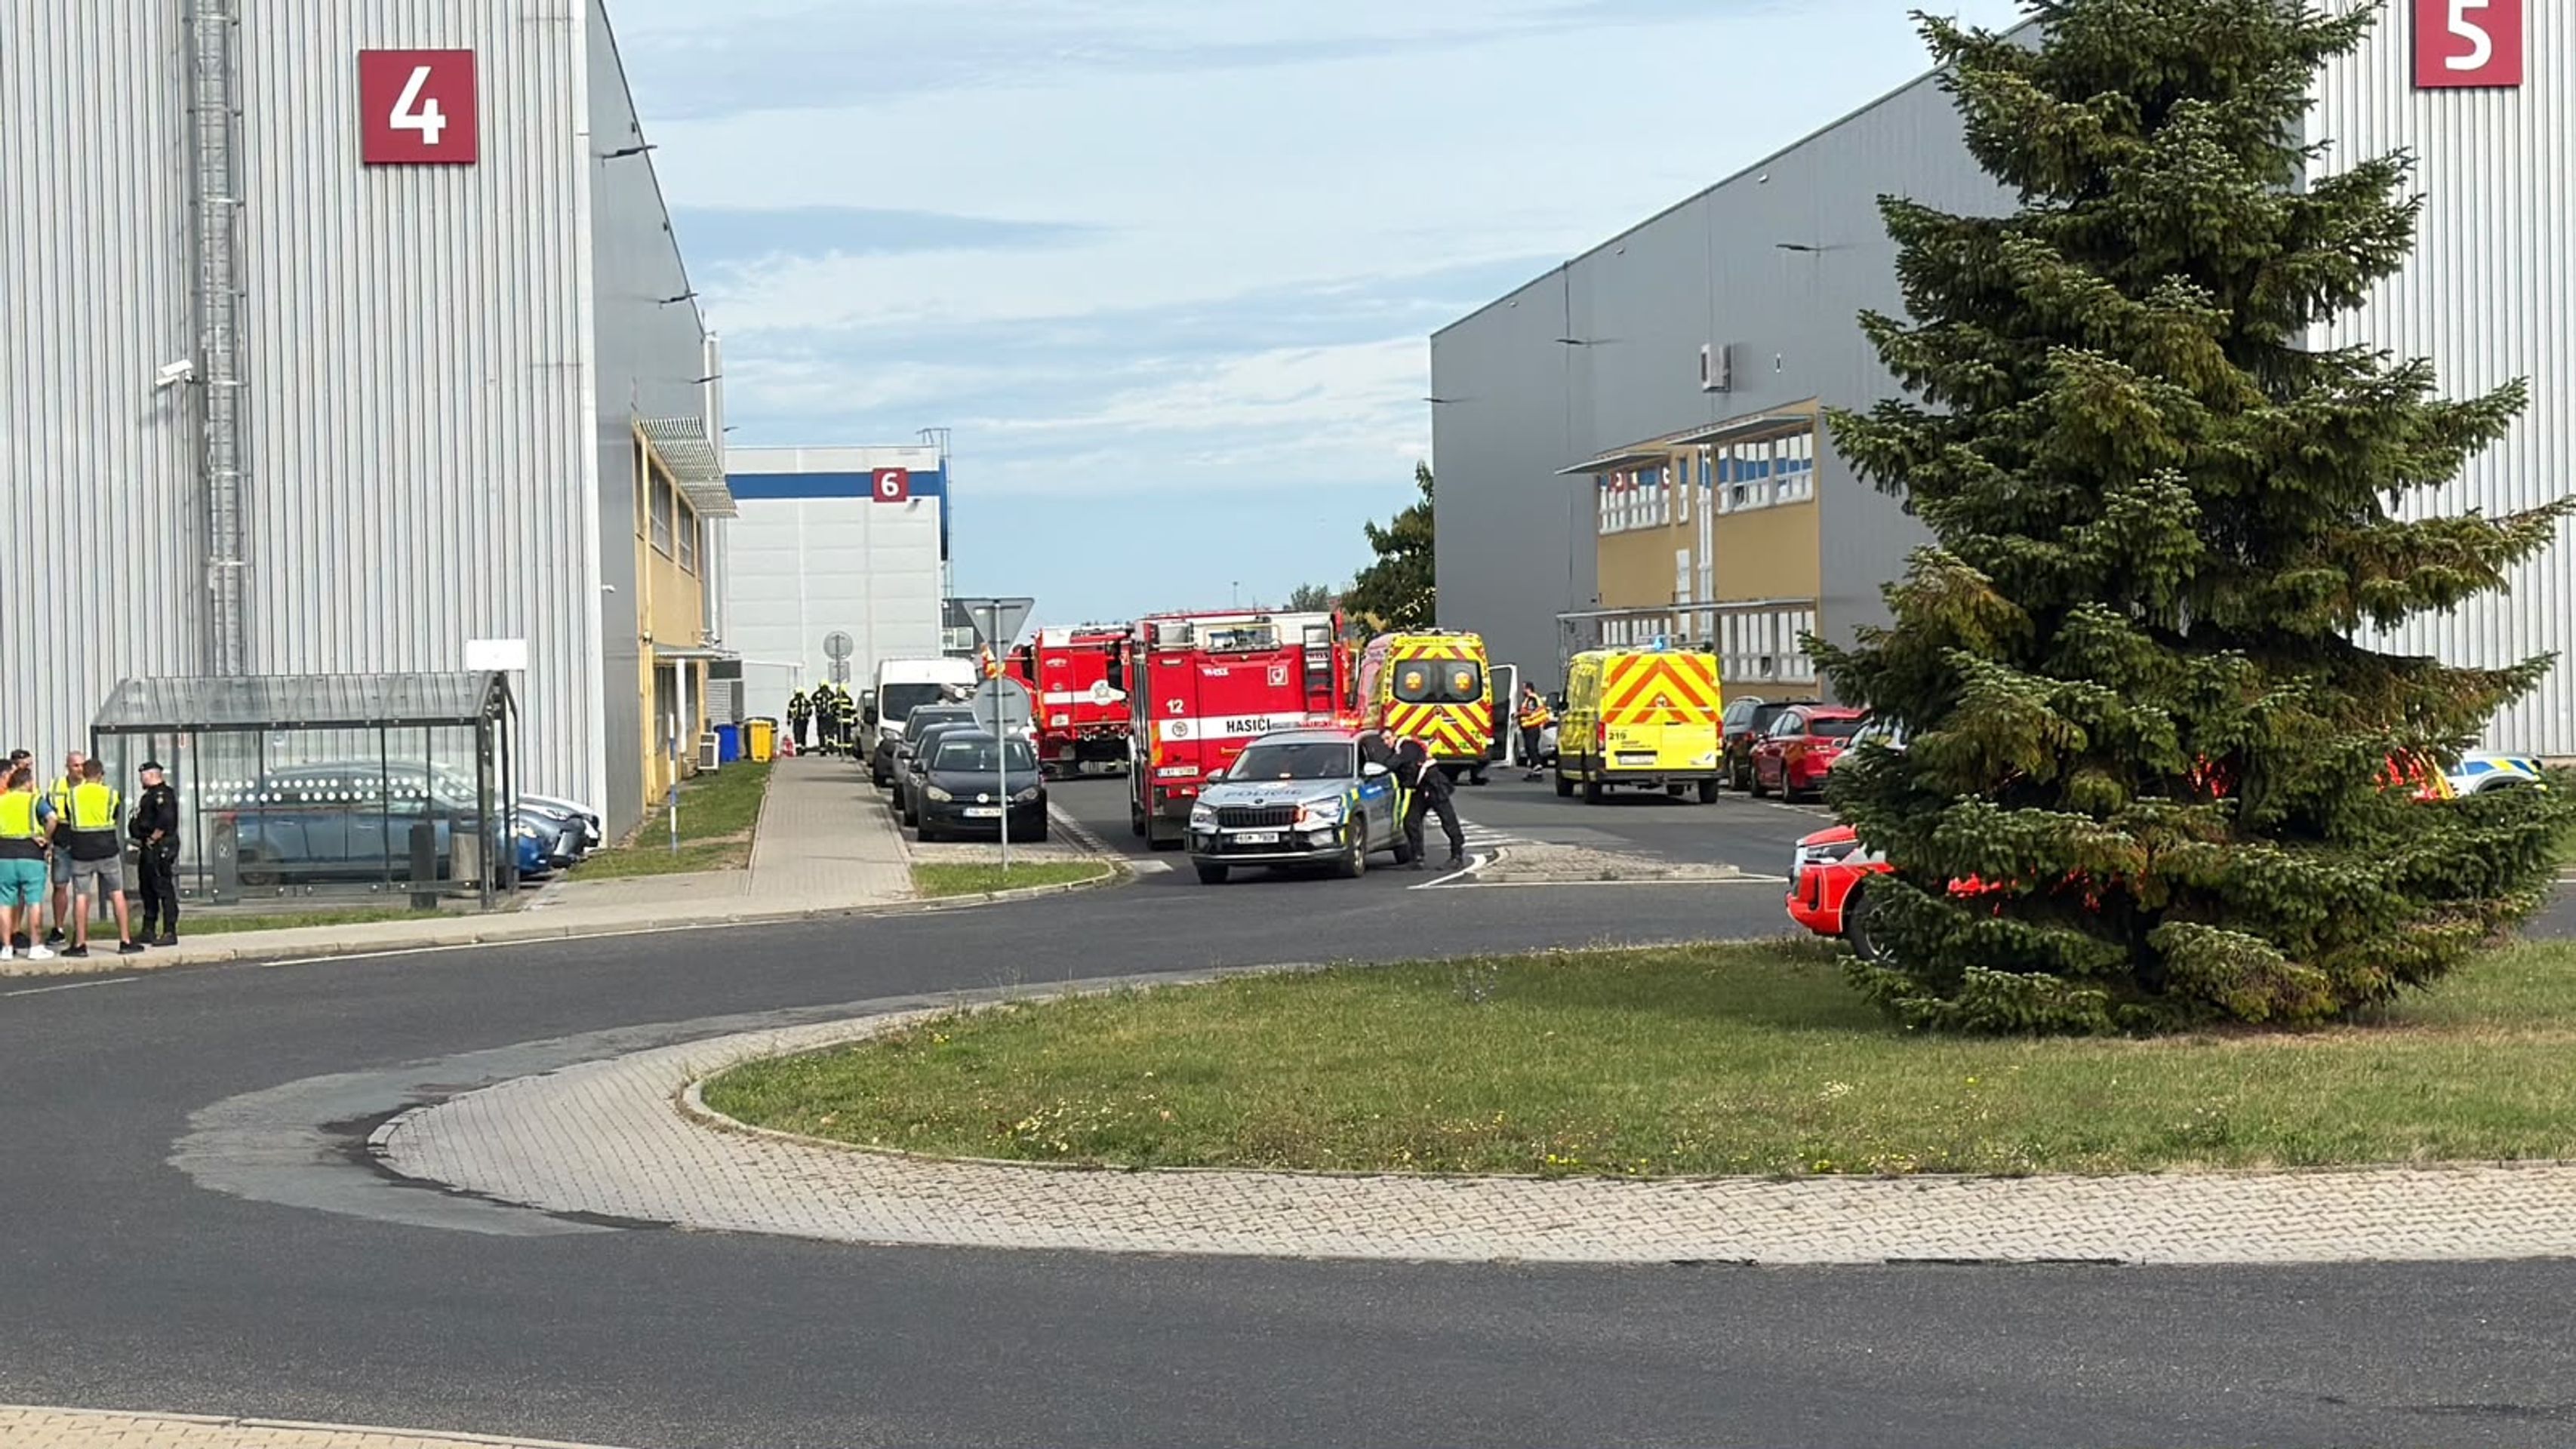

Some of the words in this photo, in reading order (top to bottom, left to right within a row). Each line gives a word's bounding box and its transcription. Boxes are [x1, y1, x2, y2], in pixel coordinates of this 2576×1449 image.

[2445, 0, 2492, 71] 5
[389, 66, 447, 145] 4
[881, 472, 899, 497] 6
[1166, 699, 1183, 714] 12
[1608, 732, 1627, 740] 219
